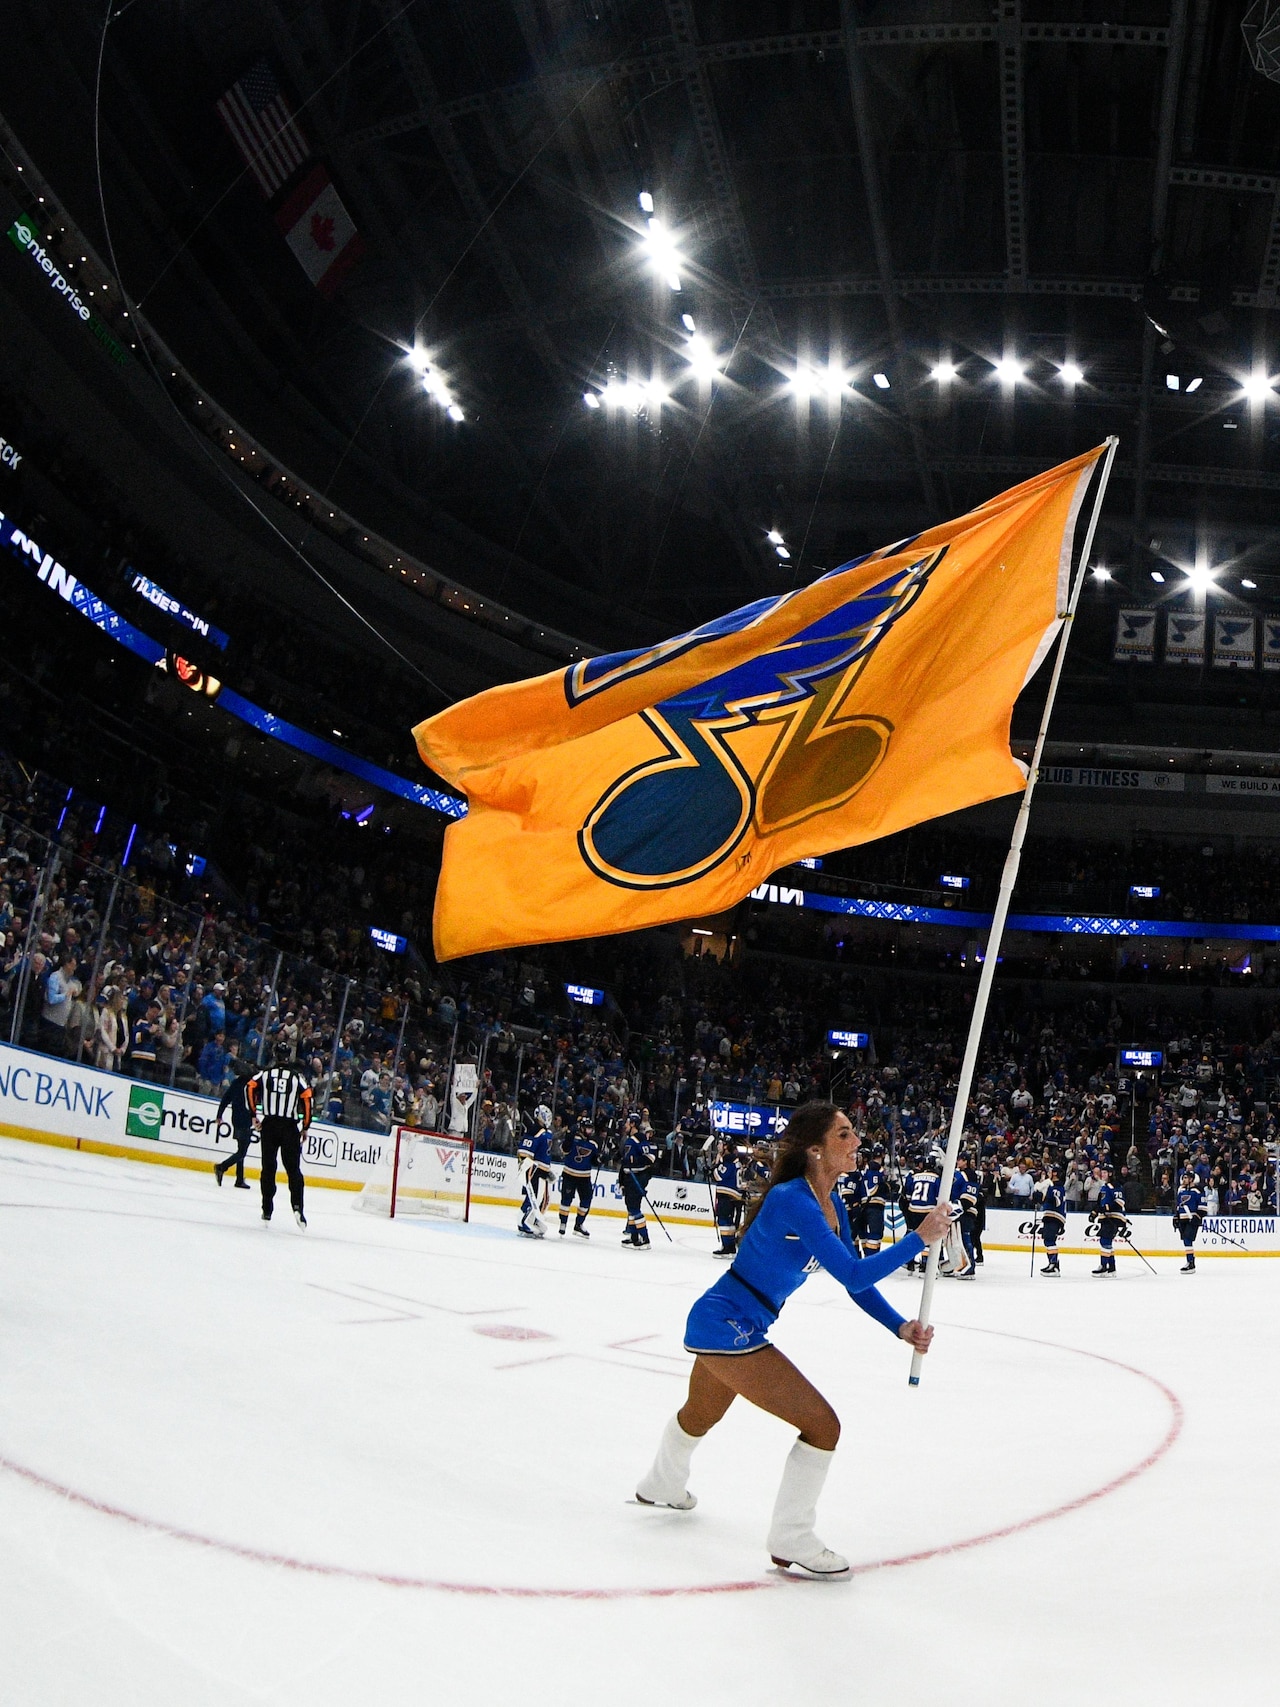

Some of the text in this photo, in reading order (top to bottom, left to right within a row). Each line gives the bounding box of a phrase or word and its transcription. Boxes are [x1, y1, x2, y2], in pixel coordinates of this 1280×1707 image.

[14, 221, 91, 321] enterprise
[1079, 769, 1140, 788] FITNESS
[1221, 780, 1237, 790] WE
[1240, 781, 1269, 791] BUILD
[371, 928, 398, 944] BLUE
[567, 985, 594, 998] BLUE
[832, 1031, 859, 1041] BLUE
[1125, 1051, 1151, 1060] BLUE
[273, 1078, 288, 1093] 19
[35, 1071, 114, 1120] BANK
[306, 1138, 335, 1159] BJC
[486, 1155, 507, 1169] Wide
[911, 1181, 930, 1202] 21
[966, 1185, 977, 1194] 30
[1201, 1218, 1275, 1234] AMSTERDAM
